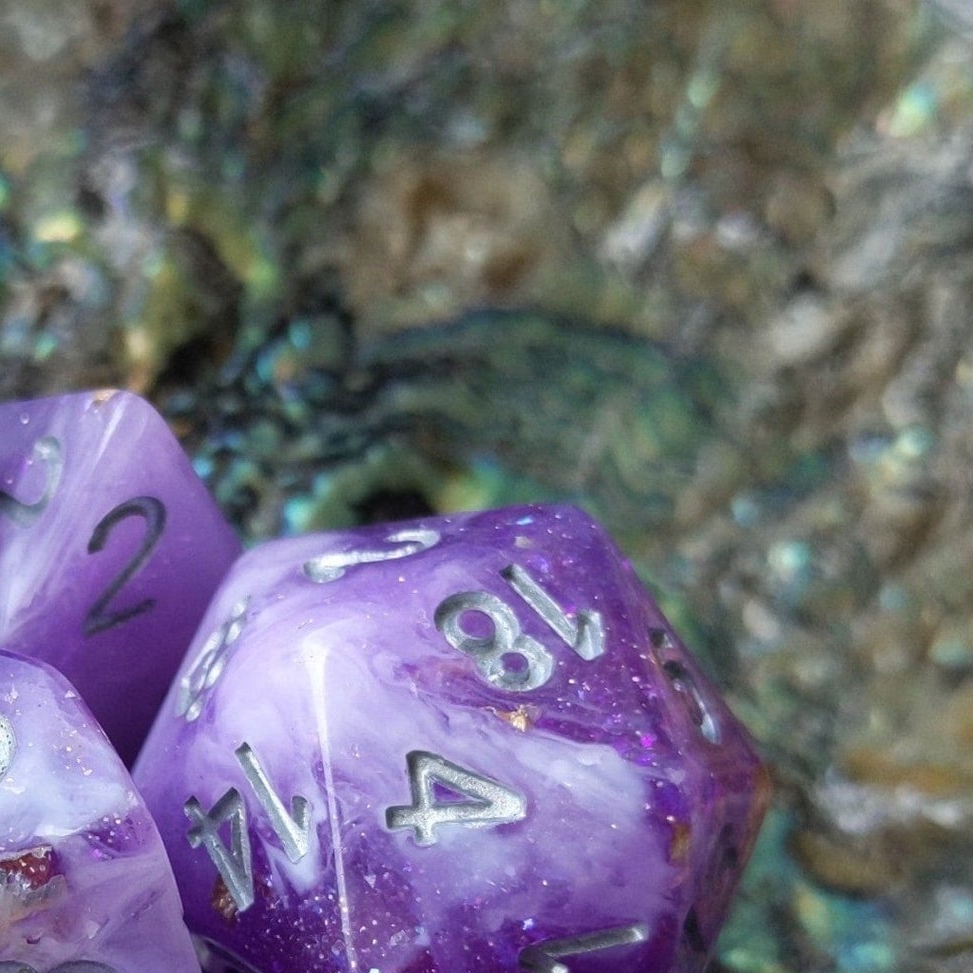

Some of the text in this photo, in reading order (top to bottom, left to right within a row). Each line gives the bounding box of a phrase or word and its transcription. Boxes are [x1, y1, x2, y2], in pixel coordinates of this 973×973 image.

[83, 495, 166, 637] 2
[434, 563, 607, 692] 18
[184, 742, 314, 912] 14
[384, 749, 526, 848] 4
